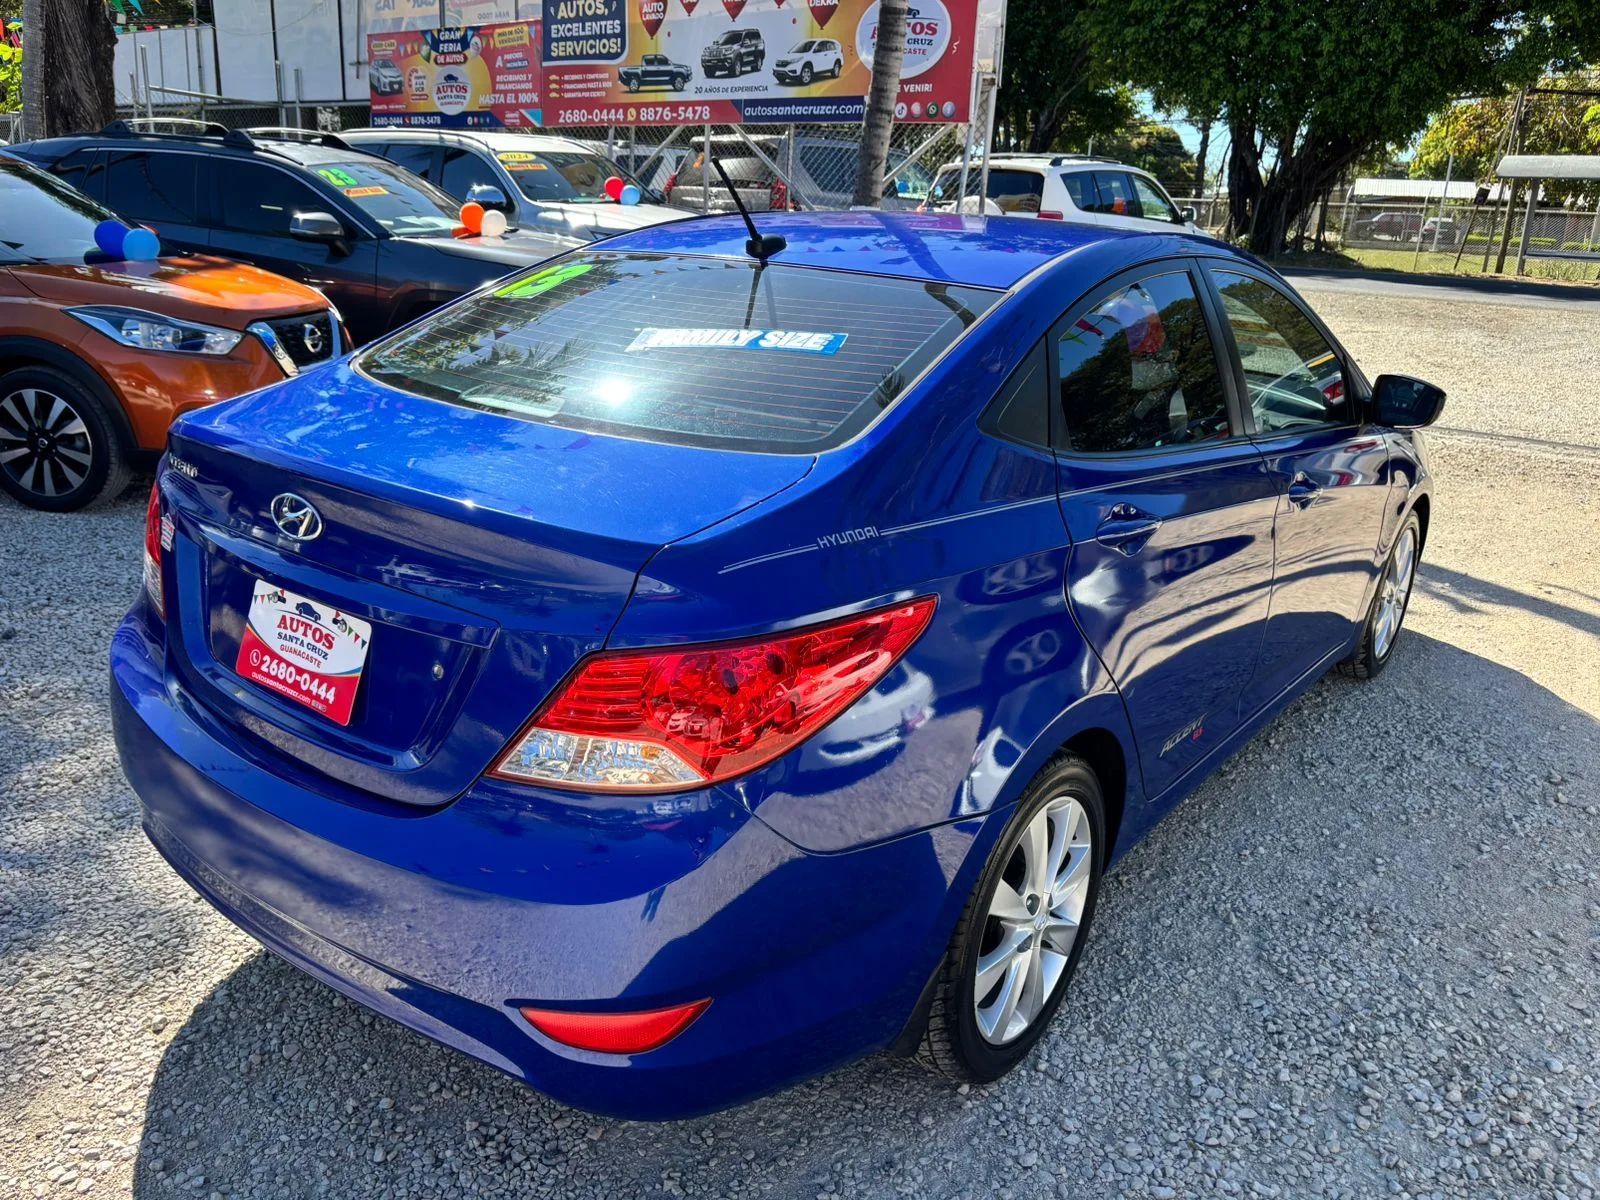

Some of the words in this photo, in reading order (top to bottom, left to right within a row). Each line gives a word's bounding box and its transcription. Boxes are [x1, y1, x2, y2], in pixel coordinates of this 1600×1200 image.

[557, 0, 609, 19] AUTOS,
[642, 2, 664, 13] AUTO
[439, 29, 461, 41] GRAN
[551, 20, 621, 38] EXCELENTES
[439, 42, 462, 53] FERIA
[551, 38, 621, 57] SERVICIOS!
[907, 38, 933, 46] CRUZ
[445, 53, 465, 63] AUTOS
[495, 55, 503, 68] A
[436, 84, 468, 95] AUTOS
[694, 86, 703, 94] 20
[704, 85, 720, 94] AÑOS
[730, 85, 768, 93] EXPERIENCIA
[904, 83, 933, 93] VENIR!
[479, 93, 505, 104] HASTA
[506, 93, 517, 104] EL
[518, 92, 539, 104] 100%
[558, 108, 624, 123] 2680-0444
[640, 105, 710, 121] 8876-5478
[744, 104, 864, 116] autossantacruzcr.com
[759, 329, 835, 351] SIZE
[816, 525, 879, 549] HYUNDAI
[277, 614, 336, 650] AUTOS
[277, 631, 305, 648] SANTA
[306, 642, 329, 661] CRUZ
[280, 644, 322, 669] GUANACASTE
[260, 655, 336, 705] 2680-0444
